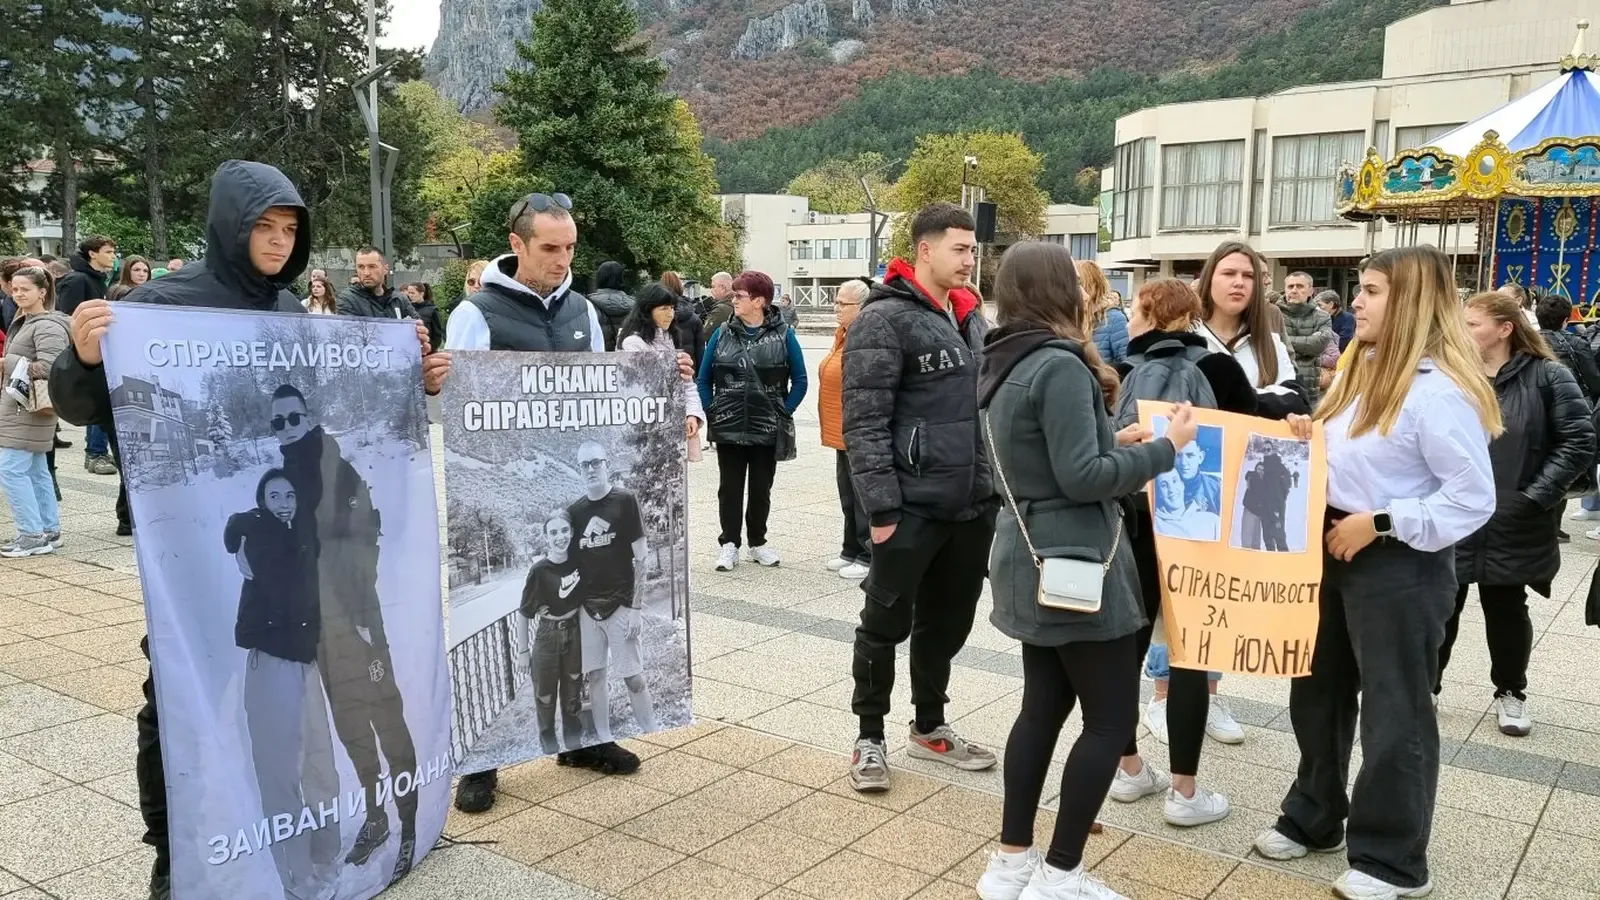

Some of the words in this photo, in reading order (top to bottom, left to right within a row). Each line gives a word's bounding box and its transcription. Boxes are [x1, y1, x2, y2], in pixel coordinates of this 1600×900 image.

[144, 338, 394, 371] СПРАВЕДЛИВОСТ
[520, 364, 618, 394] ИСКАМЕ
[463, 395, 668, 432] СПРАВЕДЛИВОСТ
[1166, 563, 1319, 604] СПРАВЕДЛИВОСТ
[1202, 604, 1228, 628] ЗА
[1197, 629, 1212, 665] И
[1232, 633, 1311, 675] ЙОАНА
[348, 787, 367, 817] И
[375, 751, 450, 806] ЙОАНА
